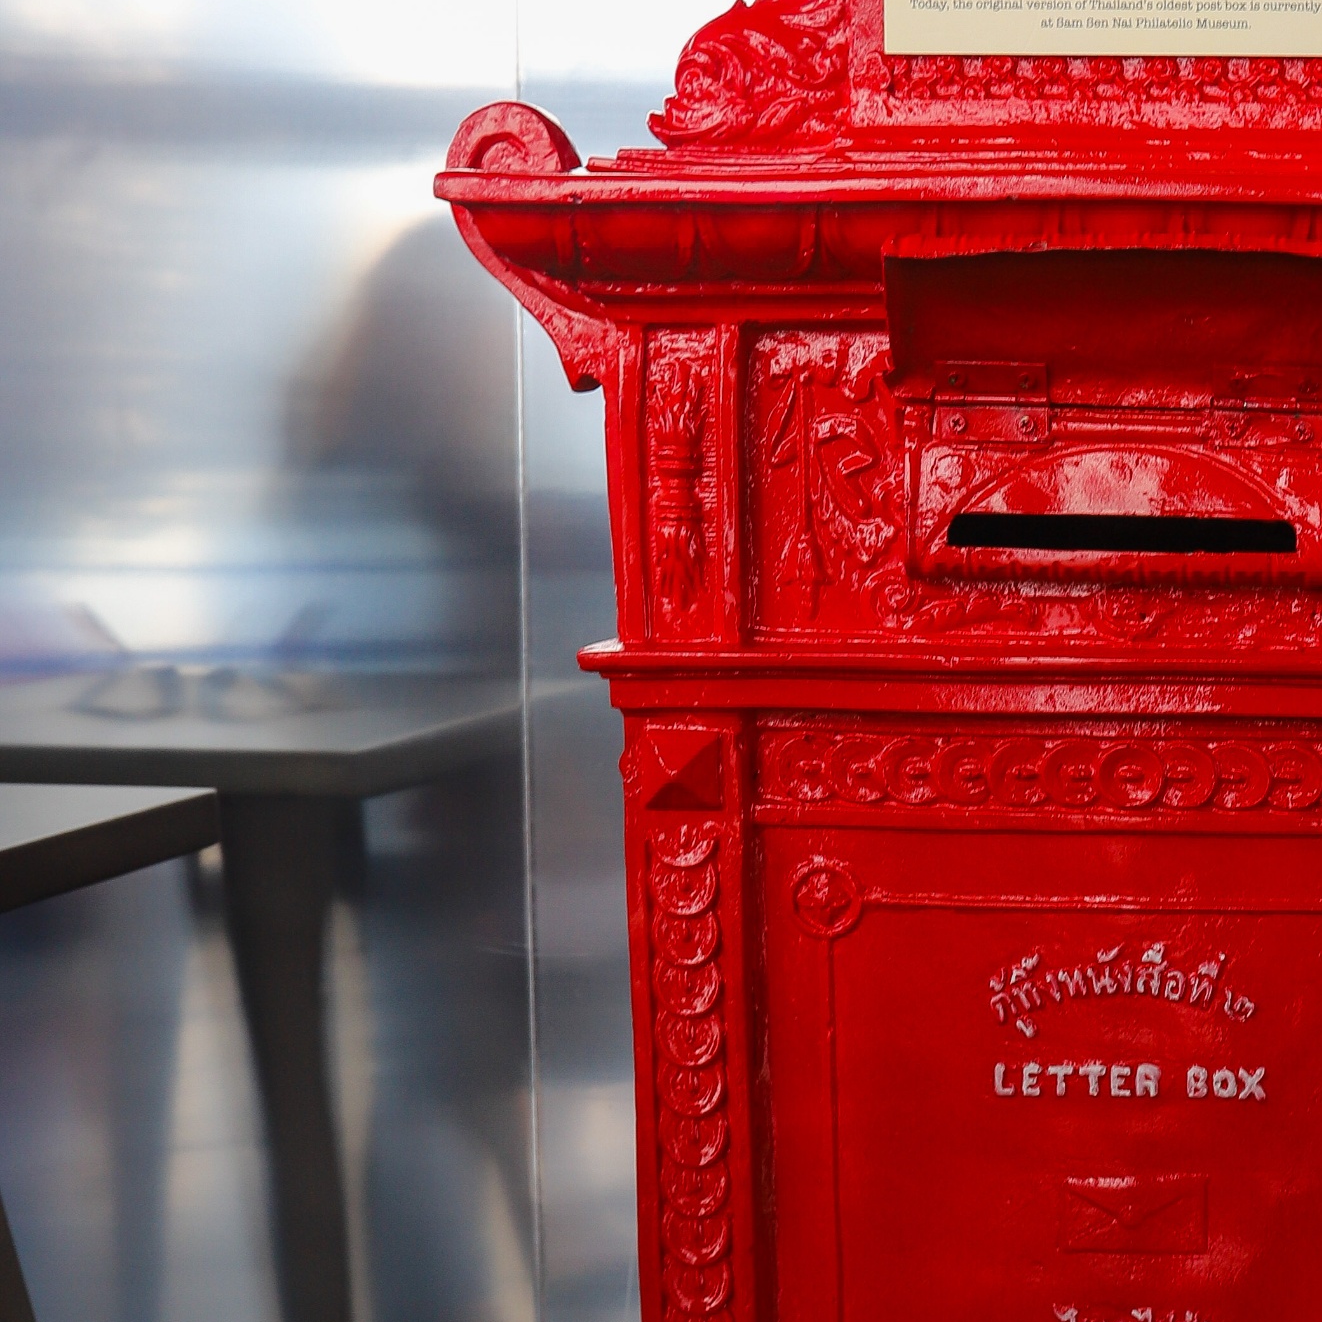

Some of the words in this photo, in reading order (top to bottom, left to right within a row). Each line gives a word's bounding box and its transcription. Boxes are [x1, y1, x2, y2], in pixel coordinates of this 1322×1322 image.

[1026, 0, 1072, 10] version
[1089, 0, 1153, 11] Thailand's
[1156, 0, 1193, 11] oldest
[1196, 1, 1222, 13] post
[1225, 0, 1247, 11] box
[1250, 0, 1260, 11] is
[1263, 0, 1321, 14] currently
[1040, 18, 1053, 29] at
[1056, 17, 1083, 29] Sam
[1086, 17, 1108, 29] Sen
[1113, 17, 1132, 29] Nai
[1136, 18, 1193, 29] Philatelic
[993, 1061, 1162, 1098] LETTER
[1186, 1063, 1266, 1101] BOX
